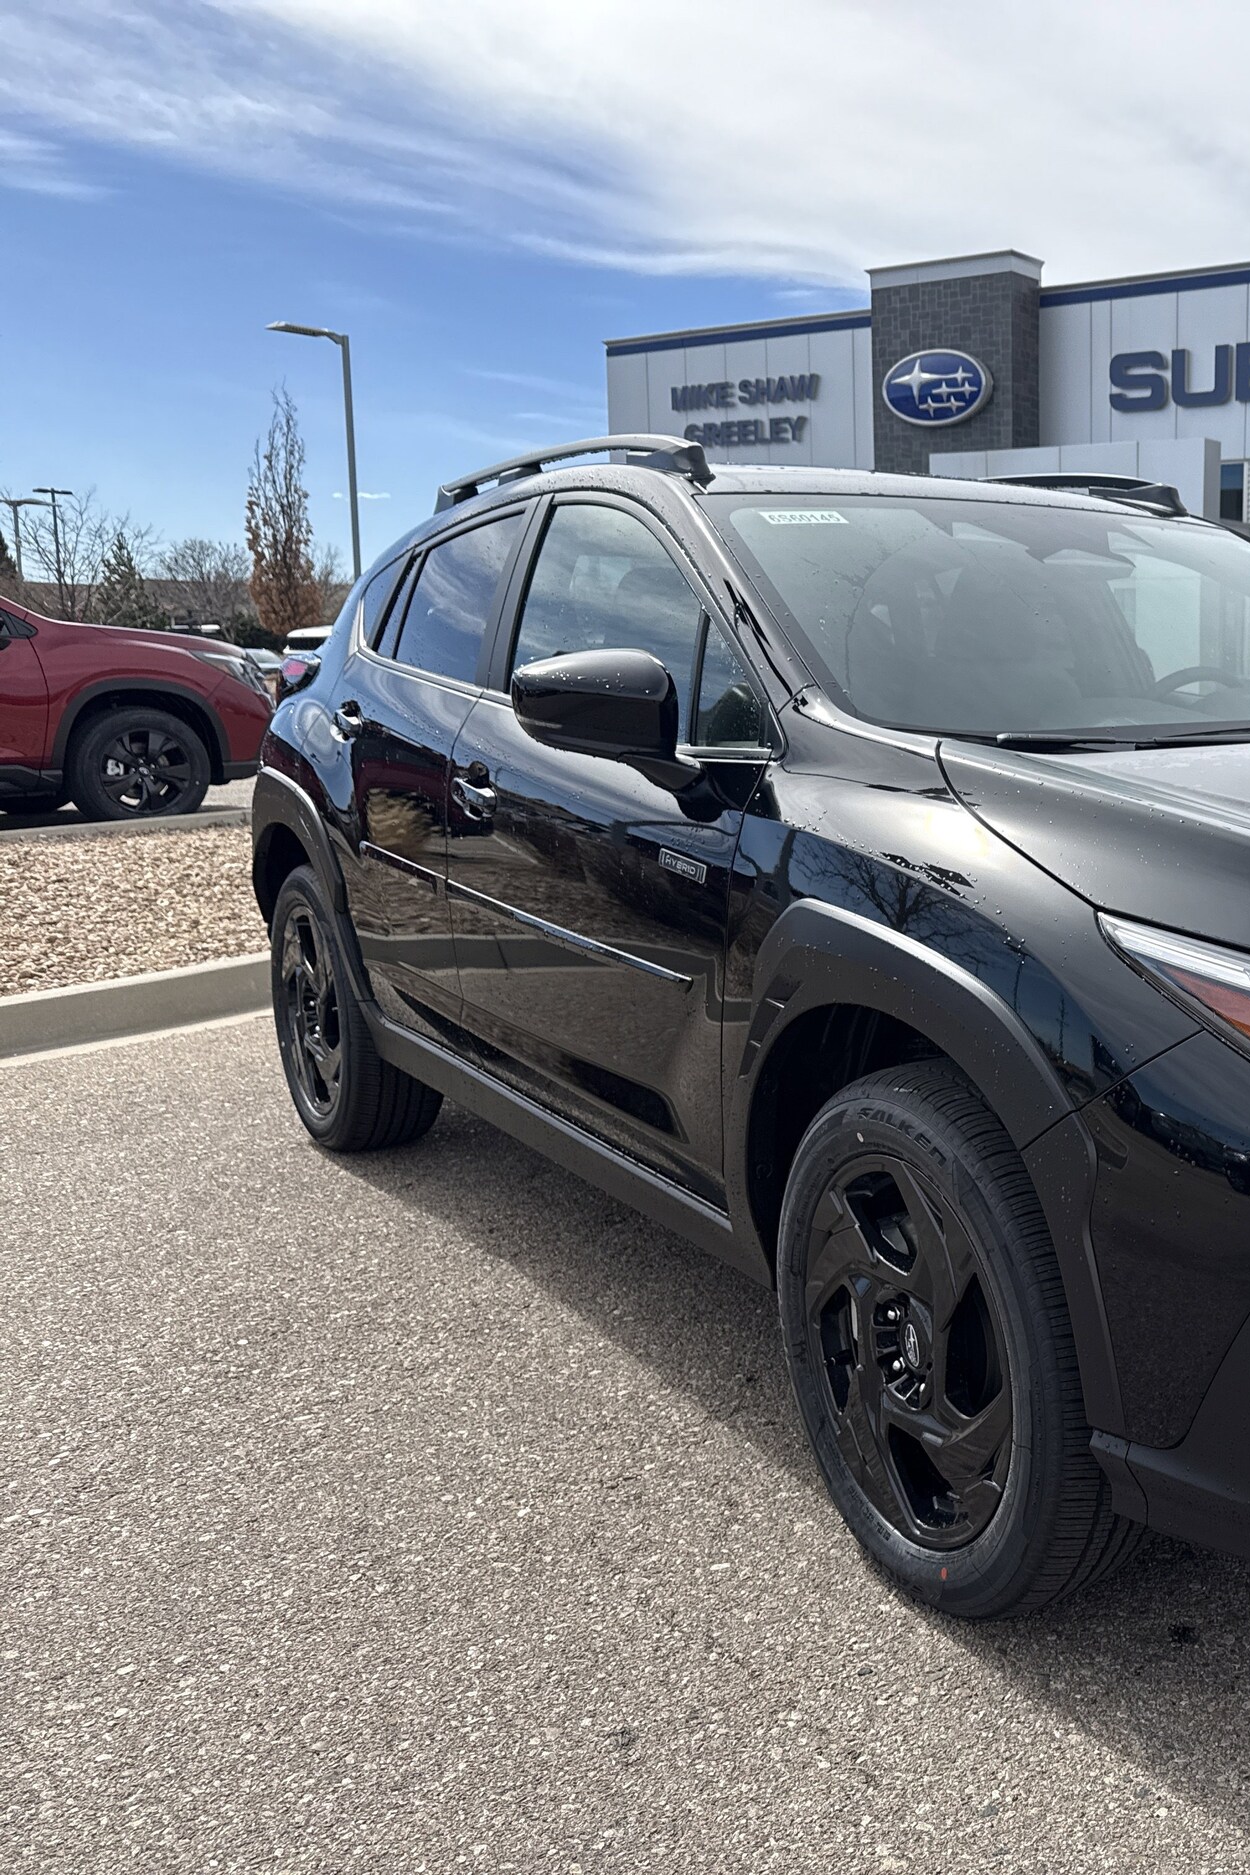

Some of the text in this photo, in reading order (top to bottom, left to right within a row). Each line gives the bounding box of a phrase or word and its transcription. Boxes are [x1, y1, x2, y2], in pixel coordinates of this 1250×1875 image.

[670, 373, 822, 412] MIKE SHAW
[684, 415, 808, 448] GREELEY
[664, 854, 697, 875] HYBRID
[856, 1107, 948, 1169] FALKEN
